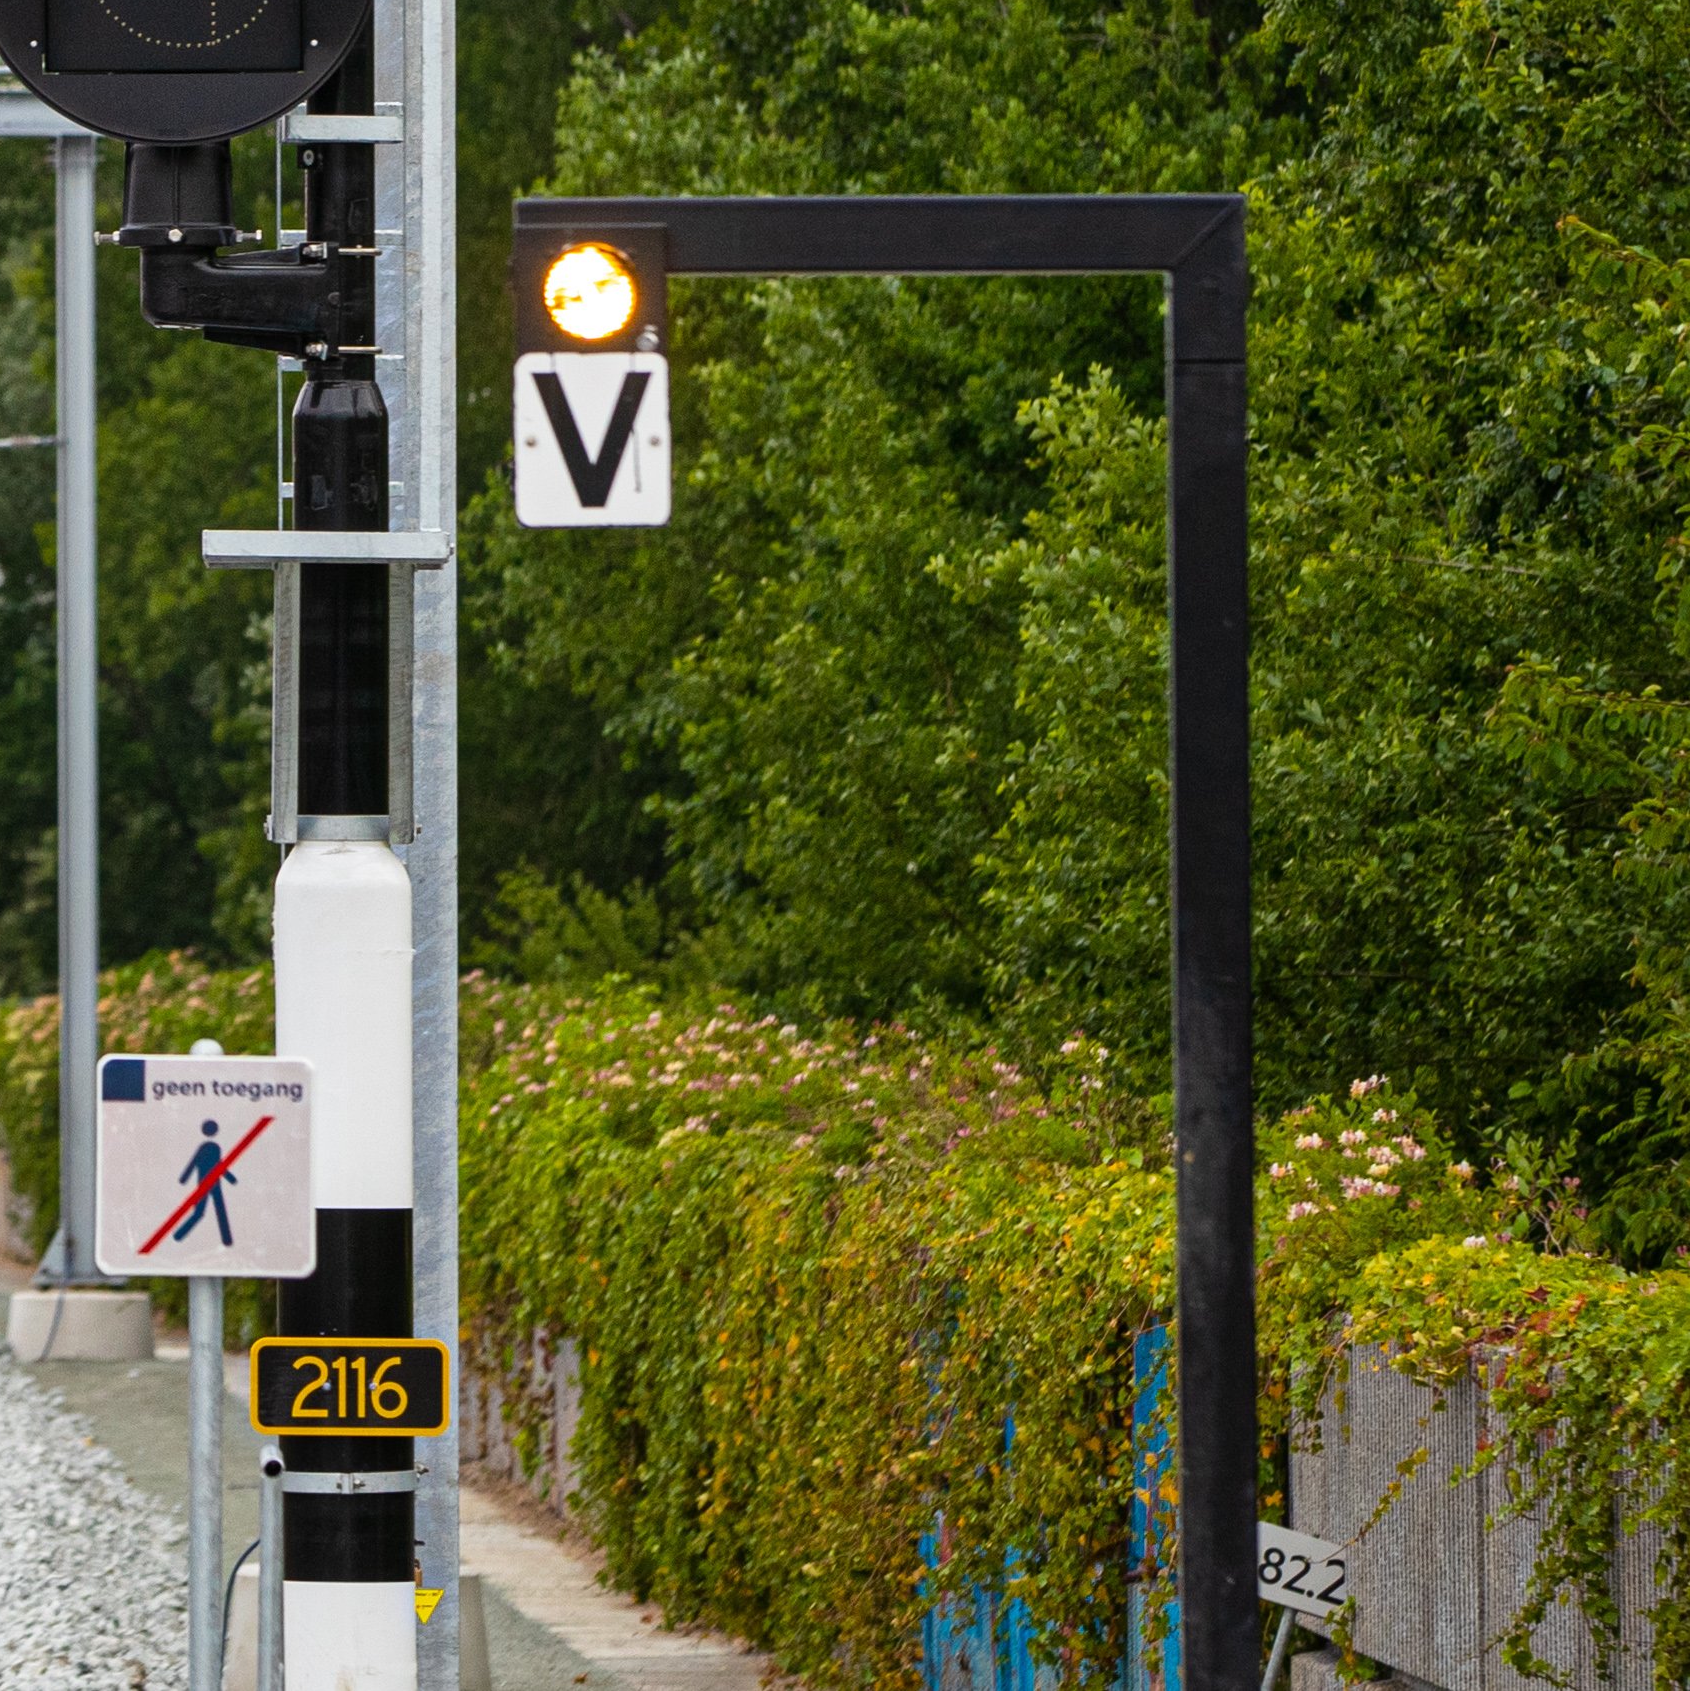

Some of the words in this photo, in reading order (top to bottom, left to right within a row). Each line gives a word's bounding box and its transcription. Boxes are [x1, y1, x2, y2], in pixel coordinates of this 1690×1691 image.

[531, 372, 652, 508] V
[152, 1081, 205, 1101] geen
[212, 1080, 303, 1103] toegang
[291, 1355, 408, 1419] 2116
